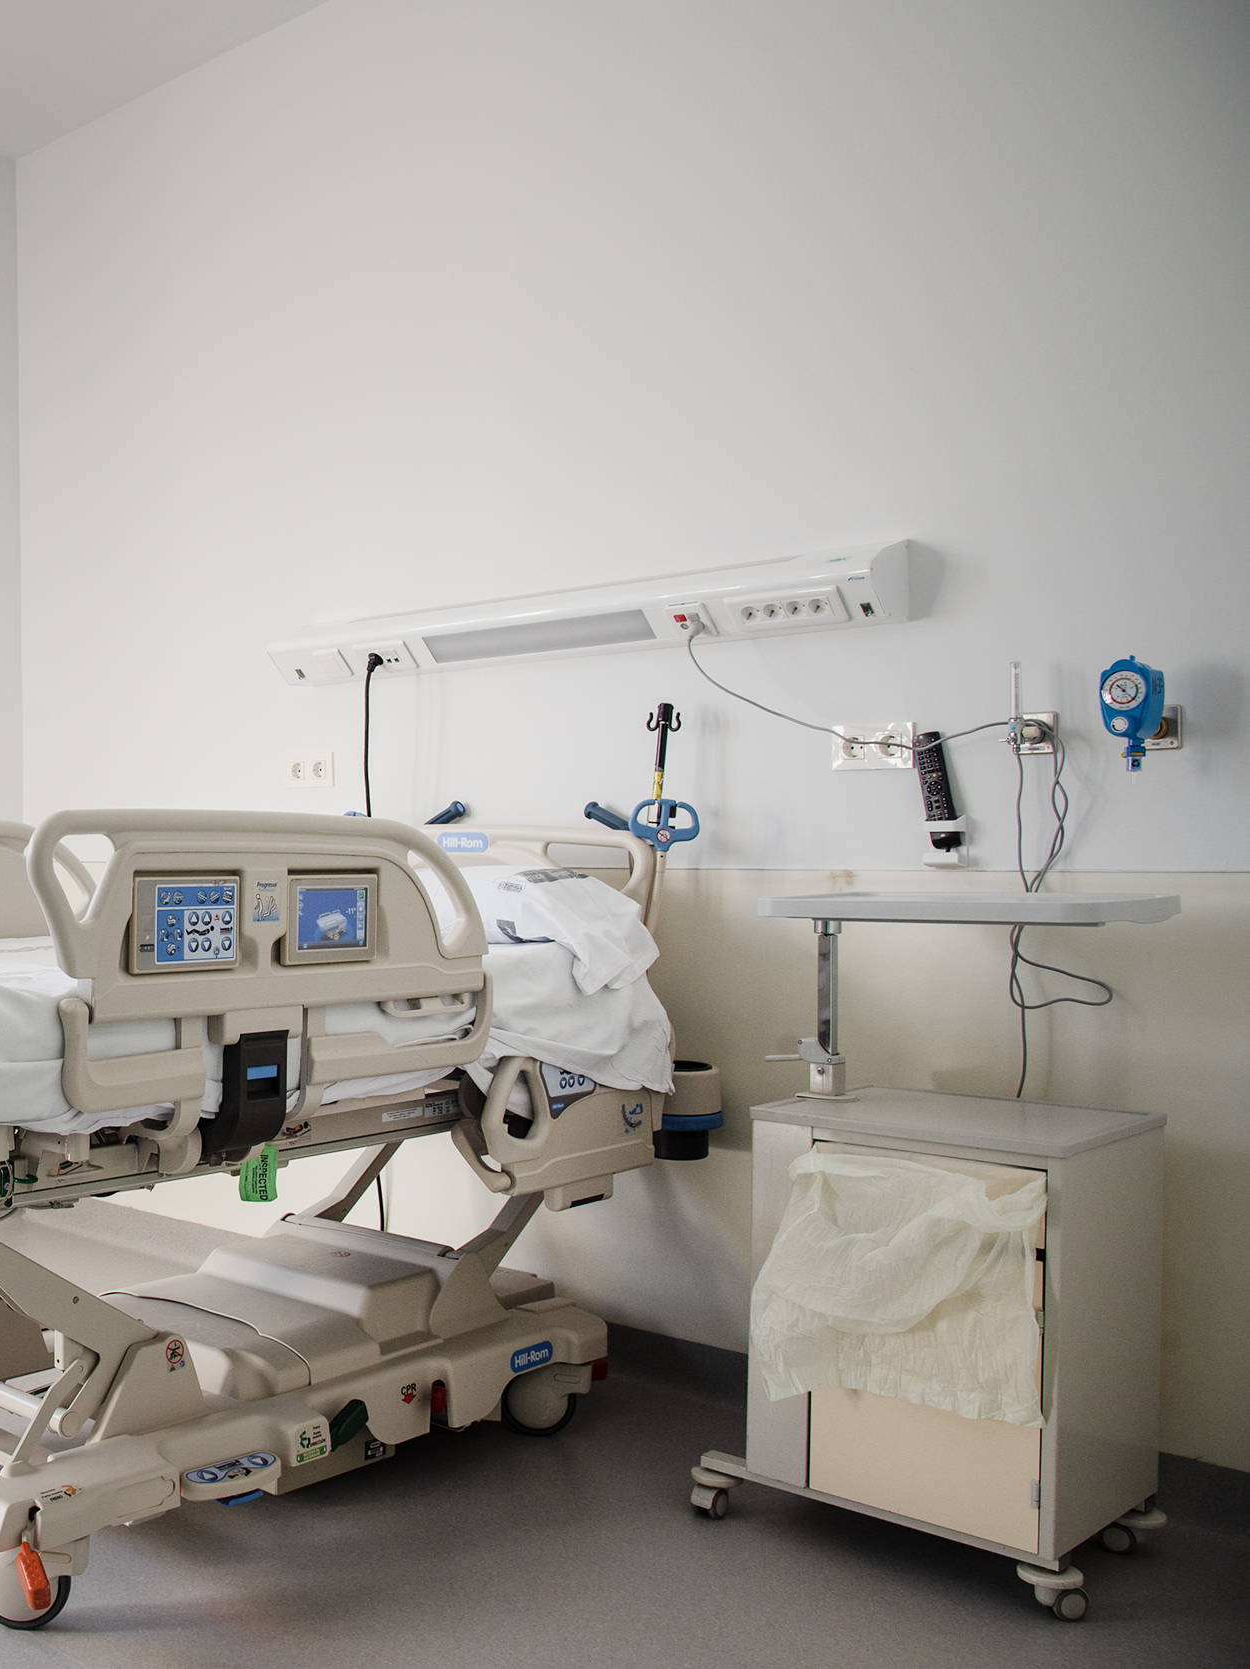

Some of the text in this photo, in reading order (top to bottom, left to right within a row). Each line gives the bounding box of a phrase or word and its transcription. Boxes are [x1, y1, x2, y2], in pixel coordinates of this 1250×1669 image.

[442, 836, 484, 849] Hill-Rom
[258, 1154, 269, 1201] INSPECTED
[514, 1348, 549, 1368] Hill-Rom
[400, 1382, 417, 1395] CPR
